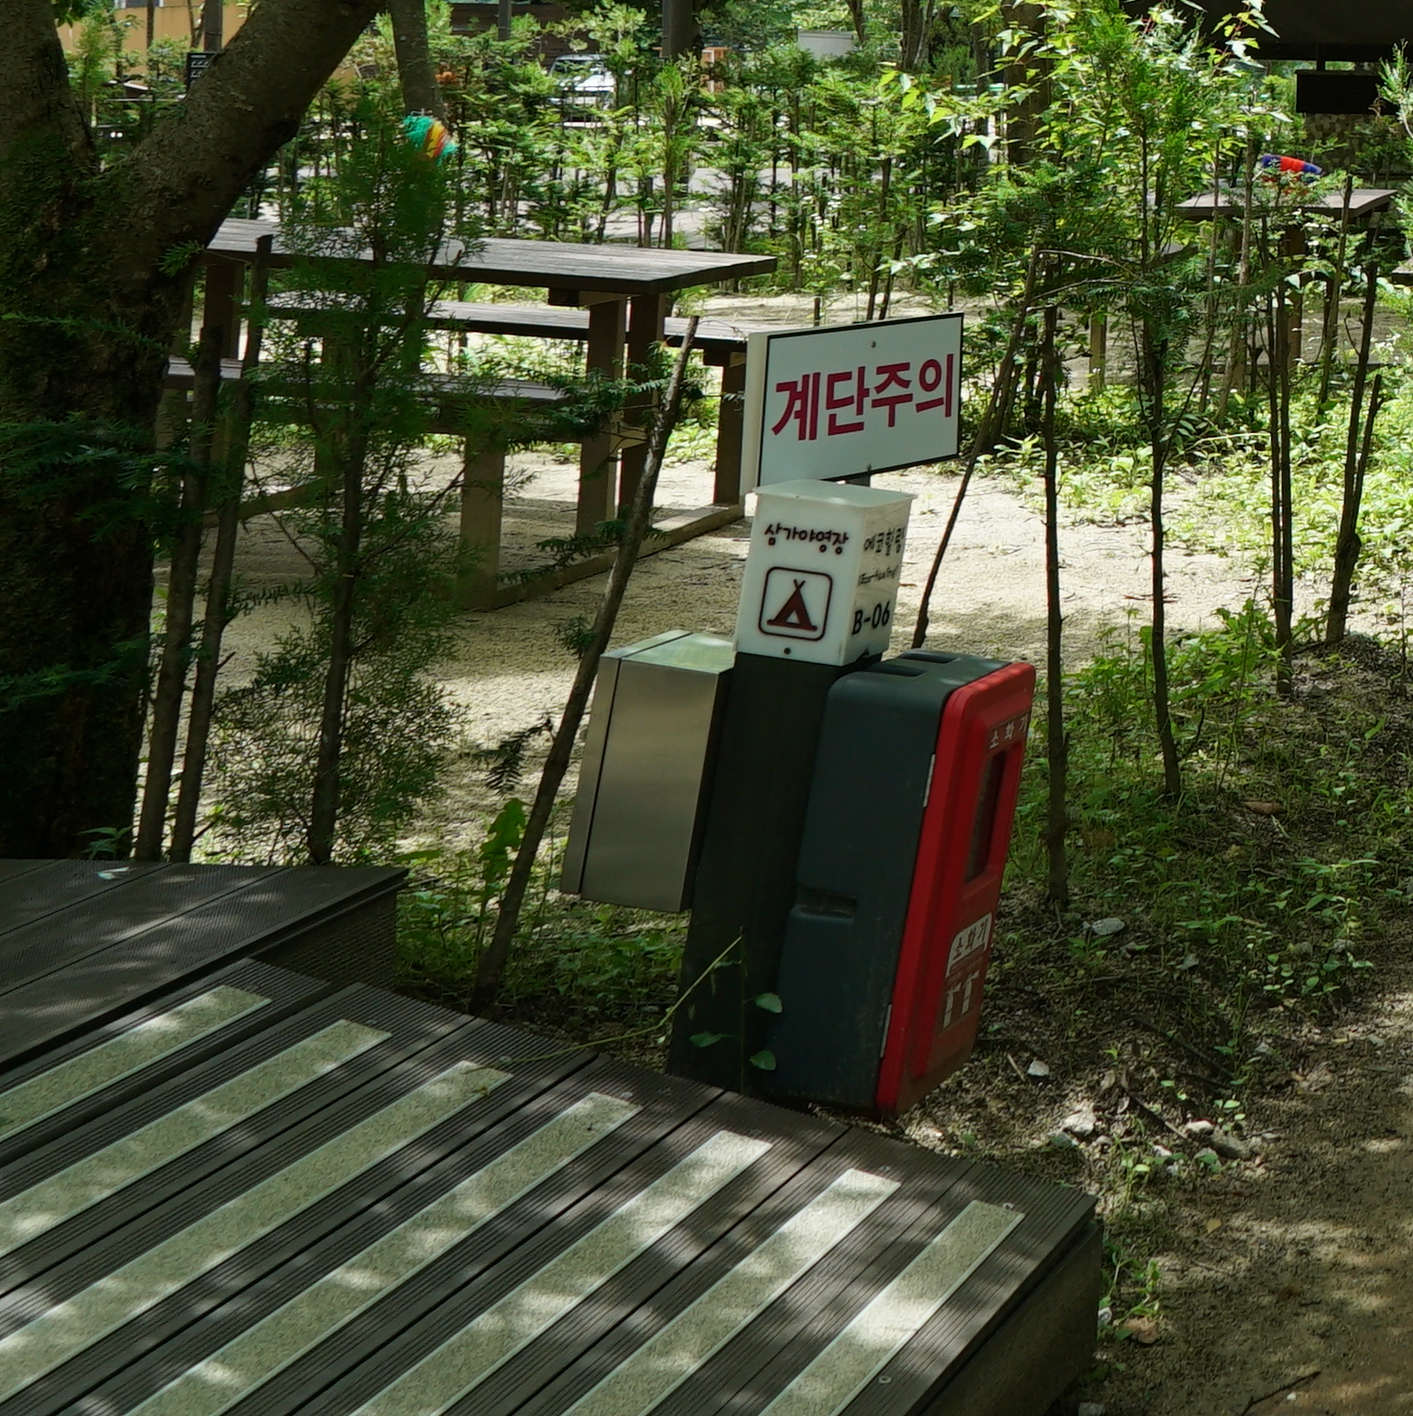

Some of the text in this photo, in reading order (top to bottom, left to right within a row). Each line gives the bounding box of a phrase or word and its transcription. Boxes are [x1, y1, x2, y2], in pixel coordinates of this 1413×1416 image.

[771, 353, 954, 441] 계단주의
[764, 522, 849, 555] 삼가야영장
[864, 526, 905, 556] 에코힐링
[852, 600, 890, 635] B-06
